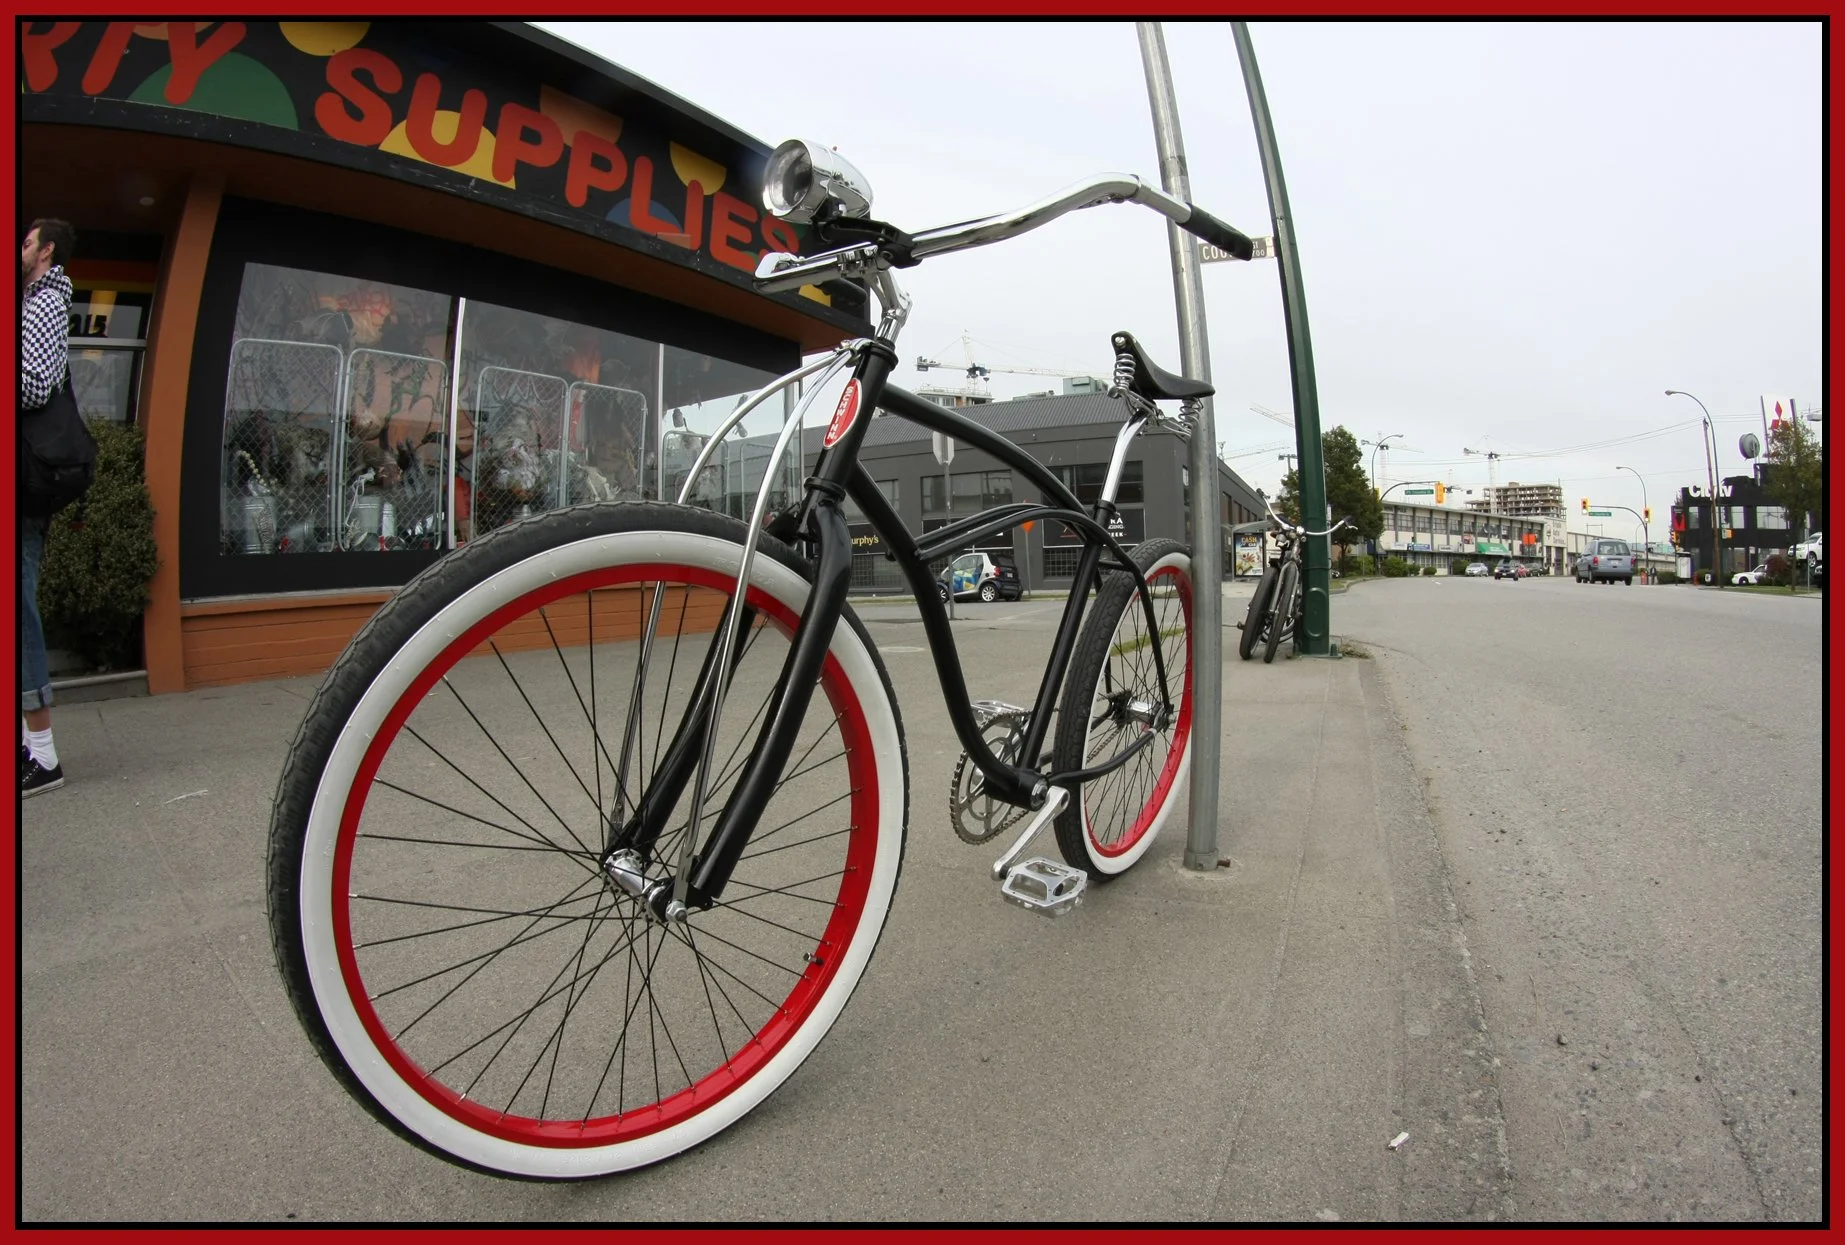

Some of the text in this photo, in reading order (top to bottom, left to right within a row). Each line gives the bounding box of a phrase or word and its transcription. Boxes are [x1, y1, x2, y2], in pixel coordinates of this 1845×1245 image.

[315, 47, 800, 274] SUPPLIES
[1202, 245, 1233, 260] COO
[827, 386, 855, 440] SCHWINN
[851, 534, 879, 547] urphy's
